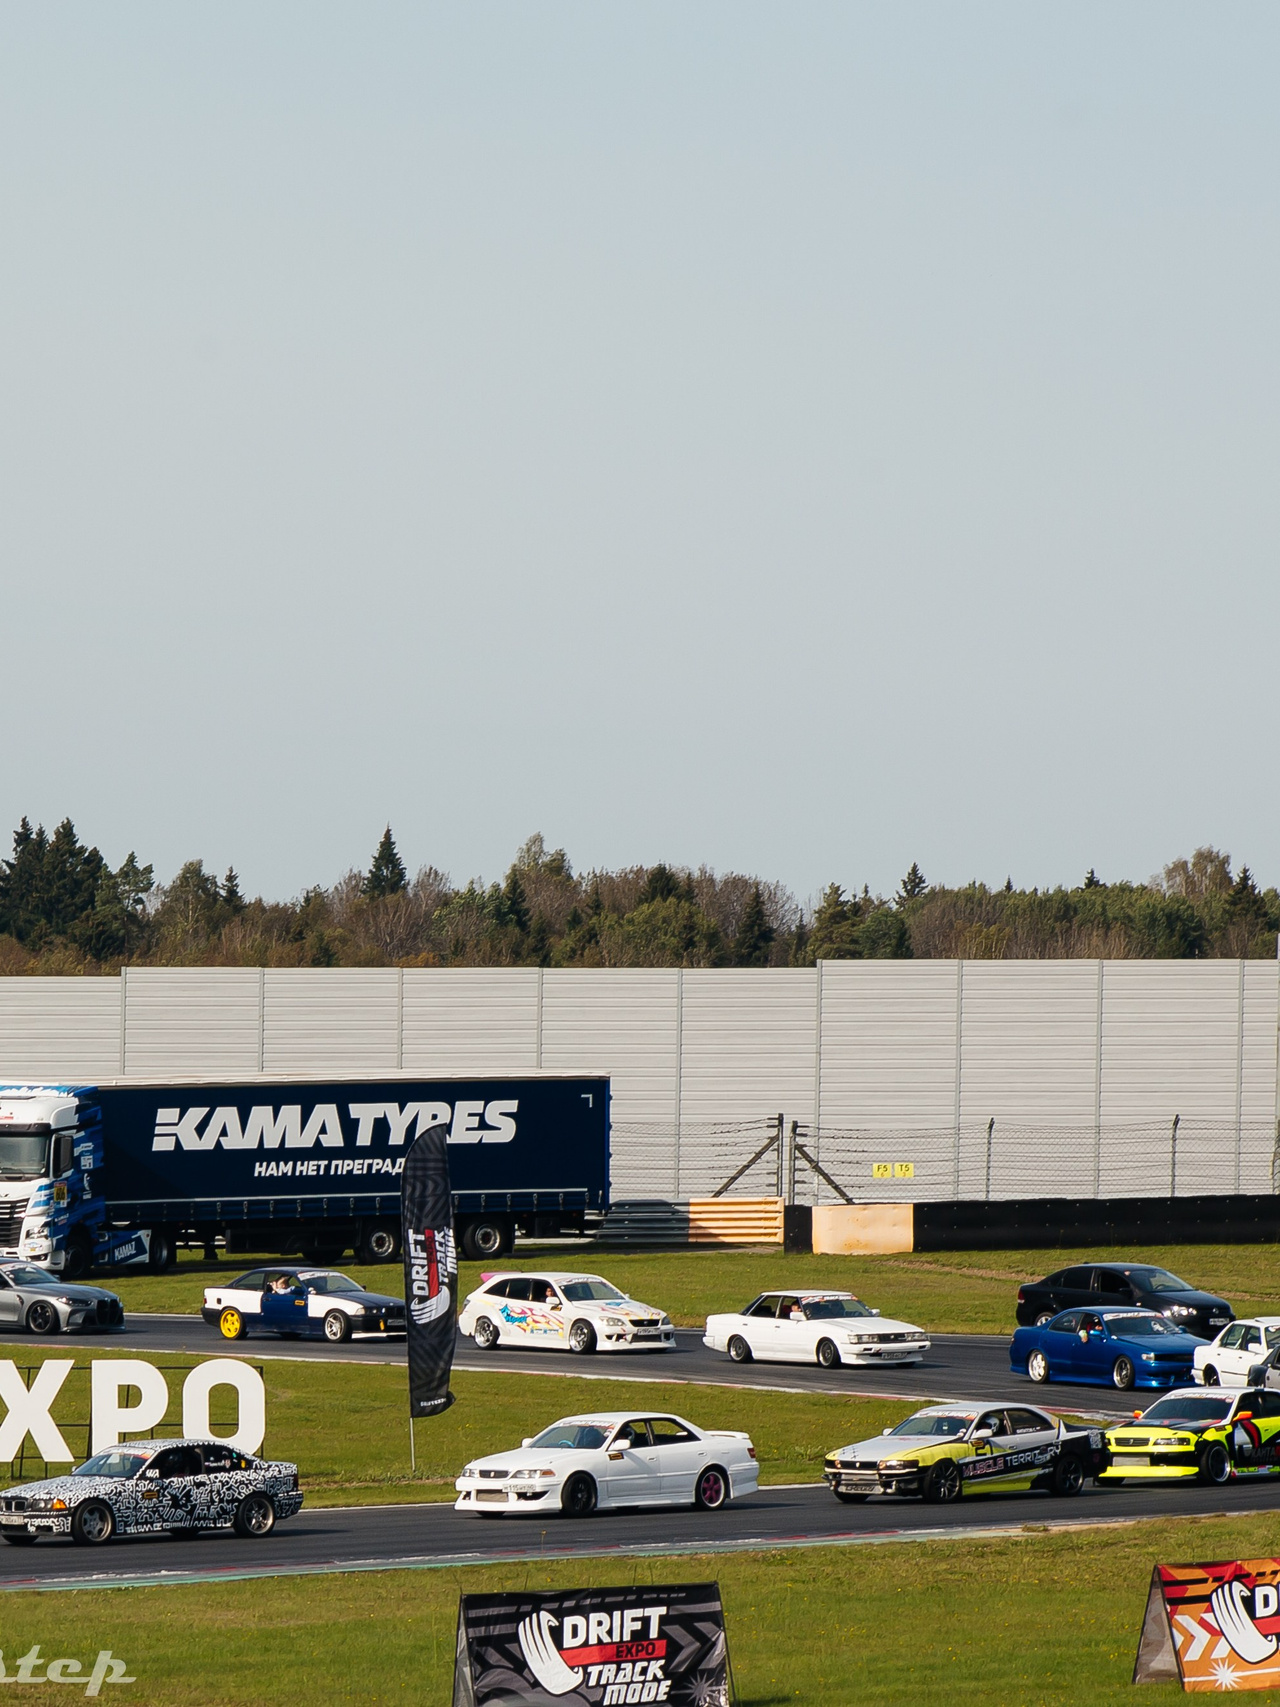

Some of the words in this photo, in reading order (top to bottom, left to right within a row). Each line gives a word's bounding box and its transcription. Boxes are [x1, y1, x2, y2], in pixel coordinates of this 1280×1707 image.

[152, 1104, 344, 1151] KAMA
[254, 1161, 293, 1177] НАМ
[295, 1160, 328, 1176] НЕТ
[899, 1164, 910, 1172] T5
[114, 1241, 137, 1260] KAMAZ
[408, 1229, 429, 1296] DRIFT
[434, 1229, 449, 1283] TRACK
[563, 1606, 667, 1648] DRIFT
[615, 1642, 656, 1658] EXPO
[587, 1660, 666, 1686] TRACK
[603, 1680, 672, 1706] MODE
